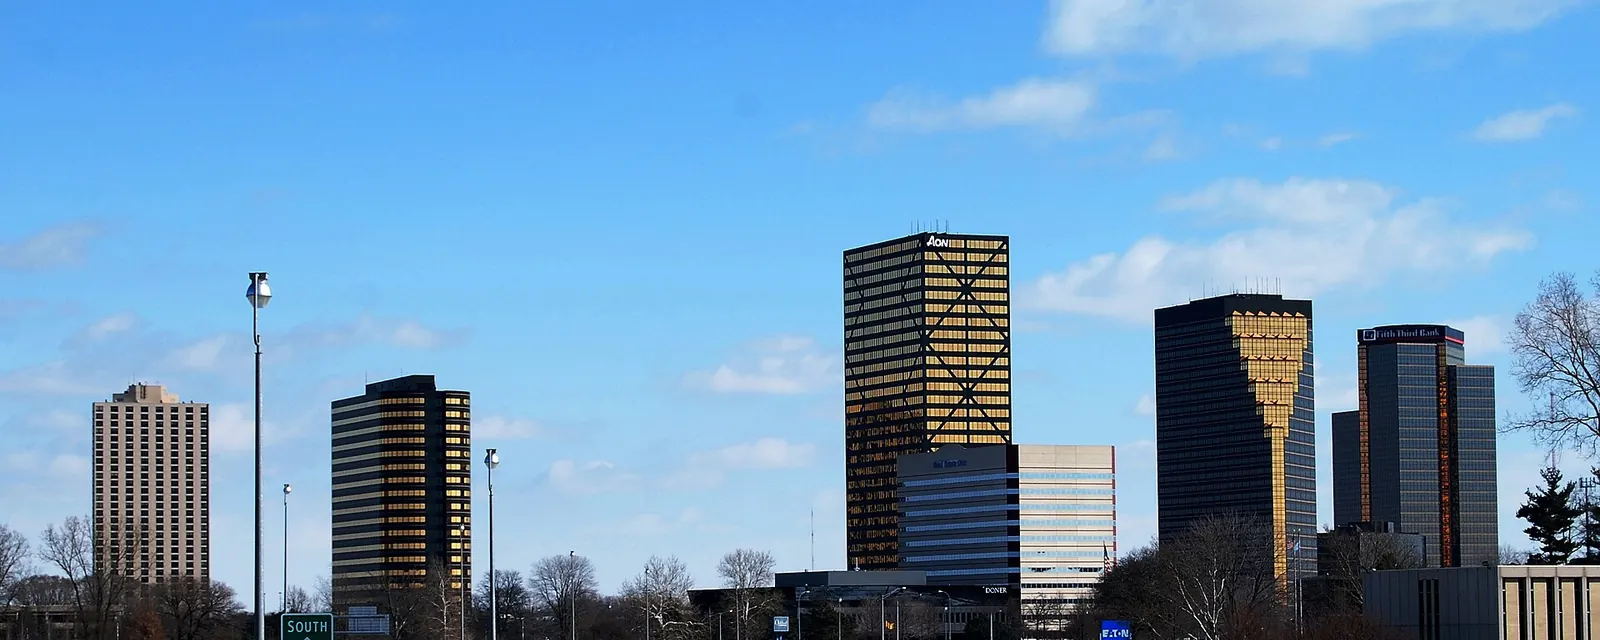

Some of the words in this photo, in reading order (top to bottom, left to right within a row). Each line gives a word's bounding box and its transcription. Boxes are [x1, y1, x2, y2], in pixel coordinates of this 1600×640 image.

[1376, 330, 1396, 338] Fifth
[1396, 329, 1418, 337] Third
[1419, 328, 1440, 336] Bank
[287, 620, 327, 632] SOUTH
